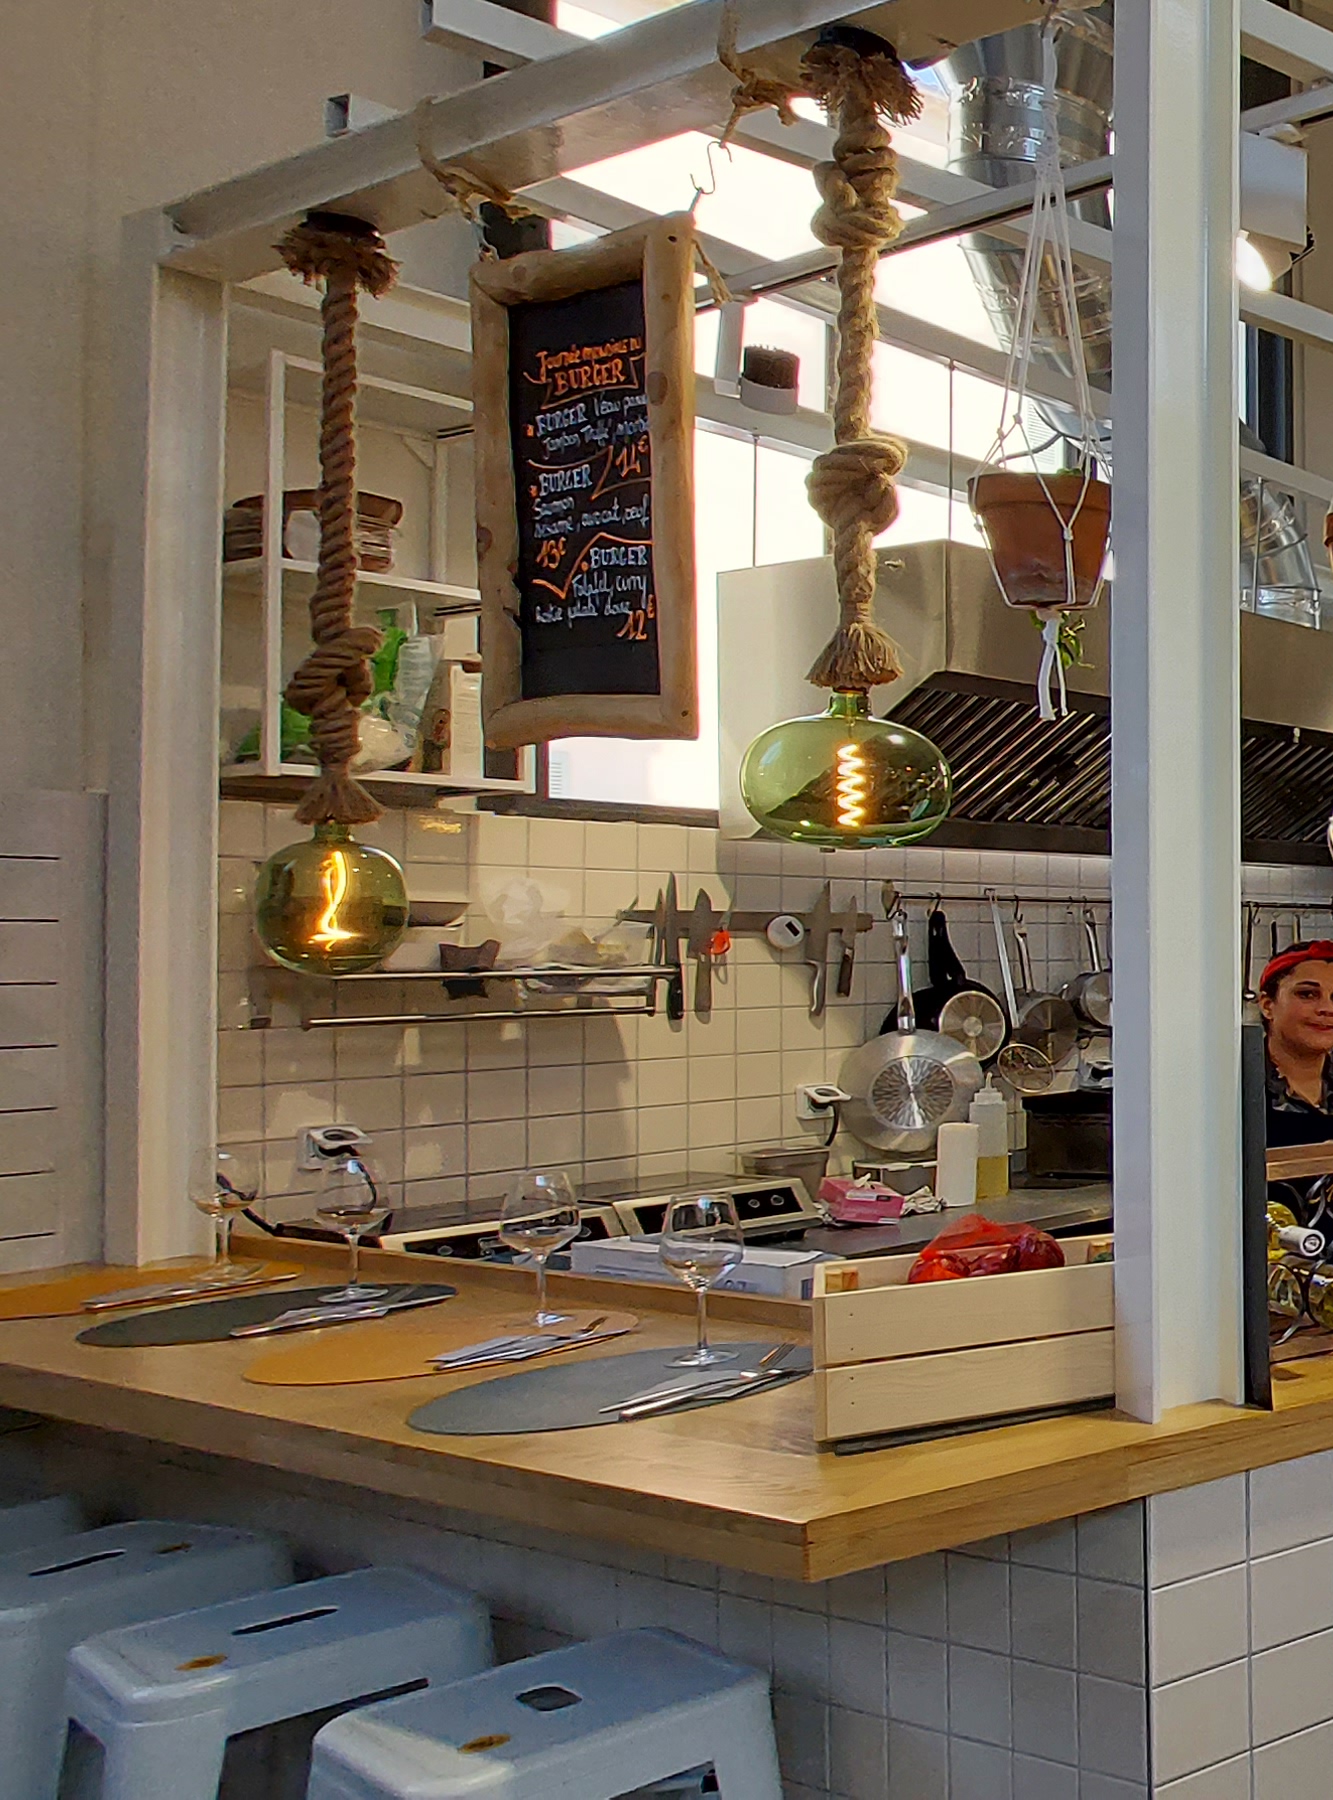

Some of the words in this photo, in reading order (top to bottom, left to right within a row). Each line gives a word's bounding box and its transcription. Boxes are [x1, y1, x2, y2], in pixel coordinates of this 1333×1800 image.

[553, 358, 627, 396] BURGER
[535, 402, 588, 438] BURGER
[539, 464, 593, 496] BURGER
[589, 545, 648, 569] BURGER
